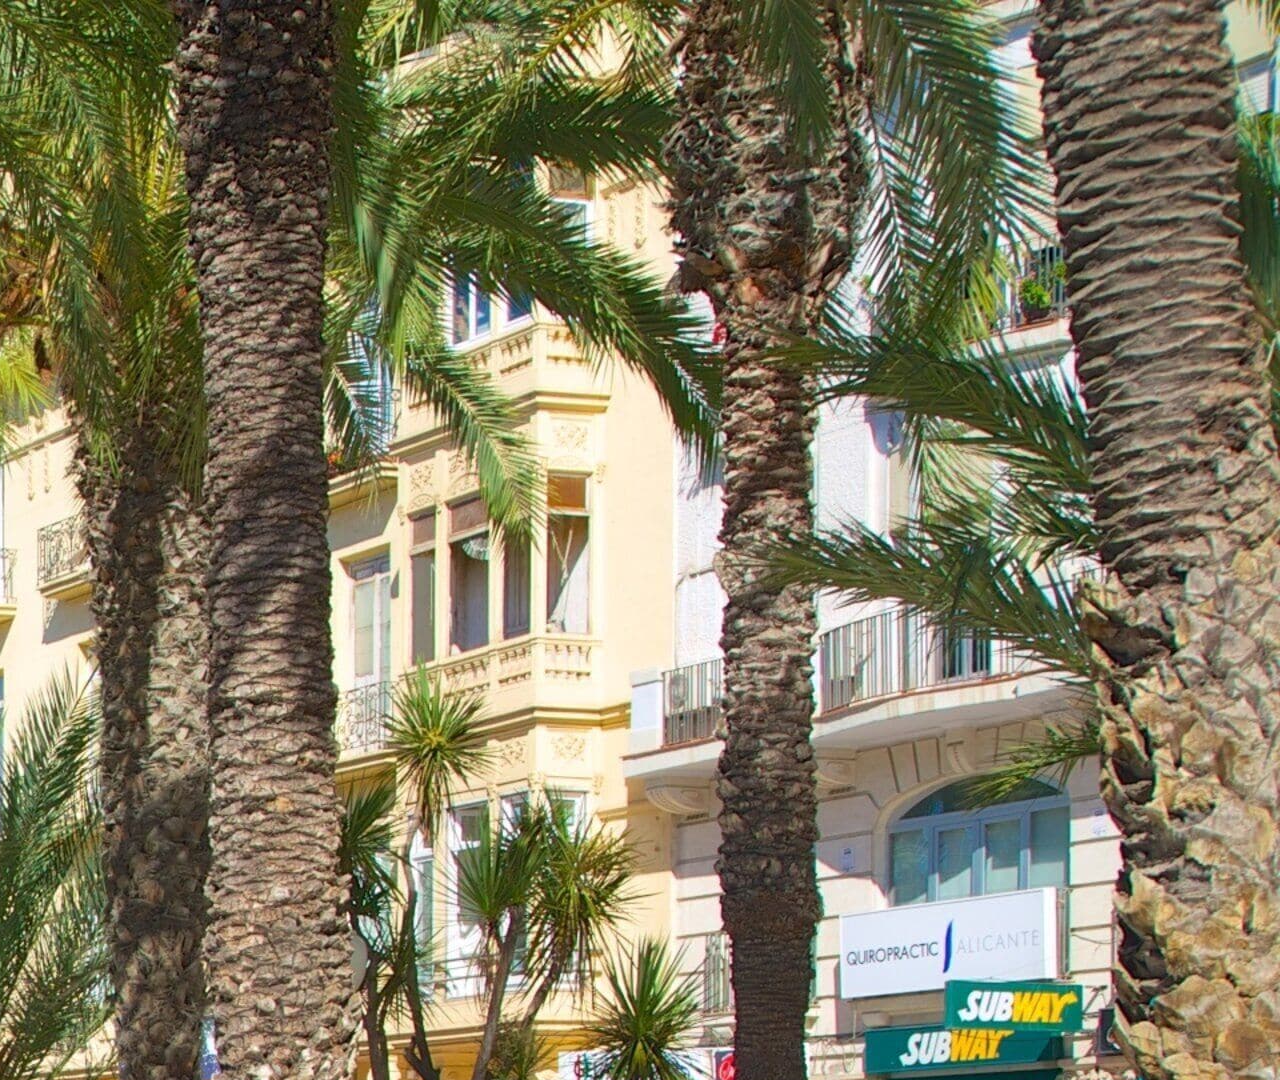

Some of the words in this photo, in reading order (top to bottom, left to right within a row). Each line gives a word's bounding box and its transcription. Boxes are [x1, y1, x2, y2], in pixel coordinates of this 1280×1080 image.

[847, 941, 939, 966] QUIROPRACTIC
[956, 930, 1041, 954] ALICANTE
[957, 990, 1078, 1023] SUBWAY
[899, 1030, 1015, 1066] SUBWAY
